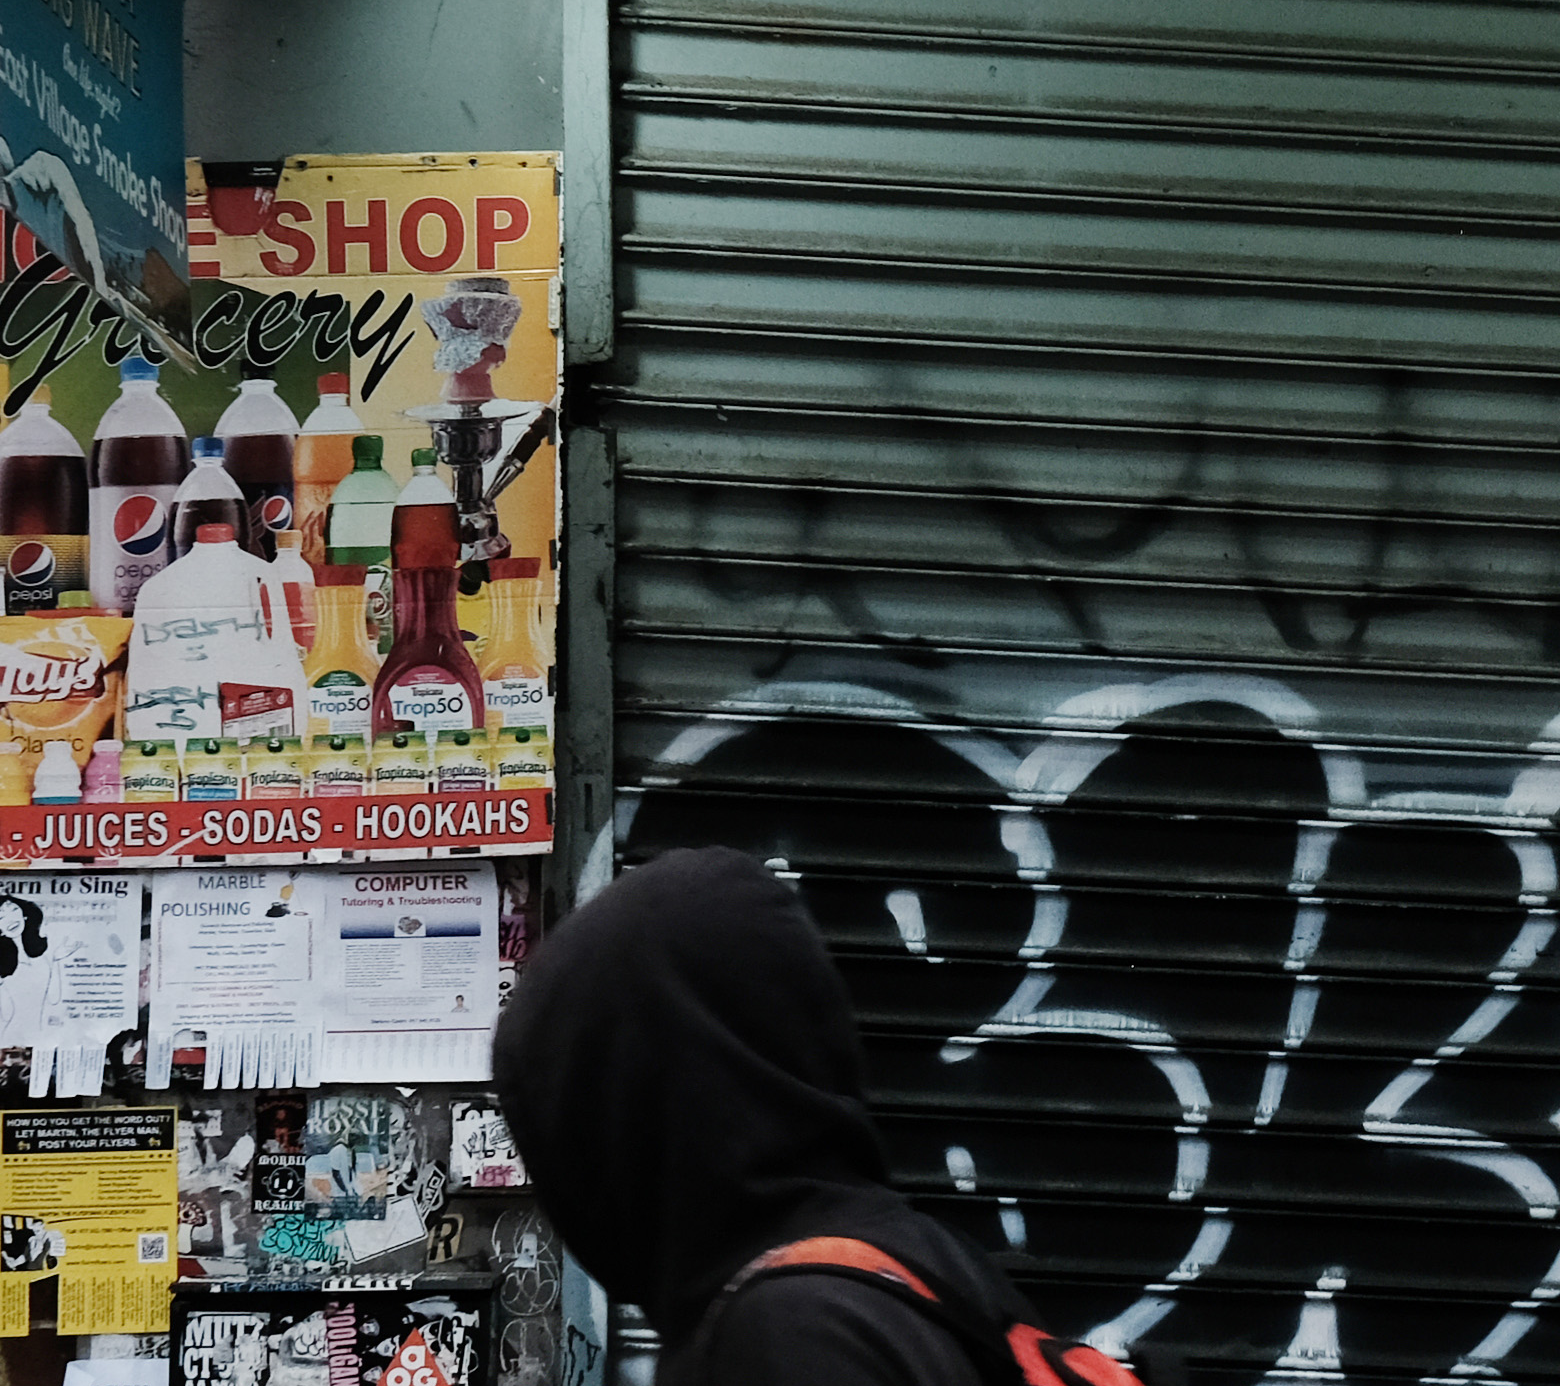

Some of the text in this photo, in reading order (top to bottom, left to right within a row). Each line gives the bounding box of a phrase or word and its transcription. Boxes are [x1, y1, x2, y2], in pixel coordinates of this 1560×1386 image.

[32, 59, 91, 165] Village
[93, 122, 148, 218] Smoke
[150, 174, 186, 259] Shop
[259, 195, 531, 277] SHOP
[8, 585, 53, 604] pepsi
[36, 811, 169, 849] JUICES
[203, 808, 323, 846] SODAS
[355, 799, 530, 840] HOOKAHS
[51, 878, 72, 895] to
[79, 876, 129, 898] Sing
[198, 875, 267, 891] MARBLE
[355, 875, 469, 893] COMPUTER
[160, 901, 252, 918] POLISHING
[399, 895, 482, 907] Troubleshooting
[308, 1117, 386, 1135] ROYAL
[254, 1199, 305, 1211] REALIT
